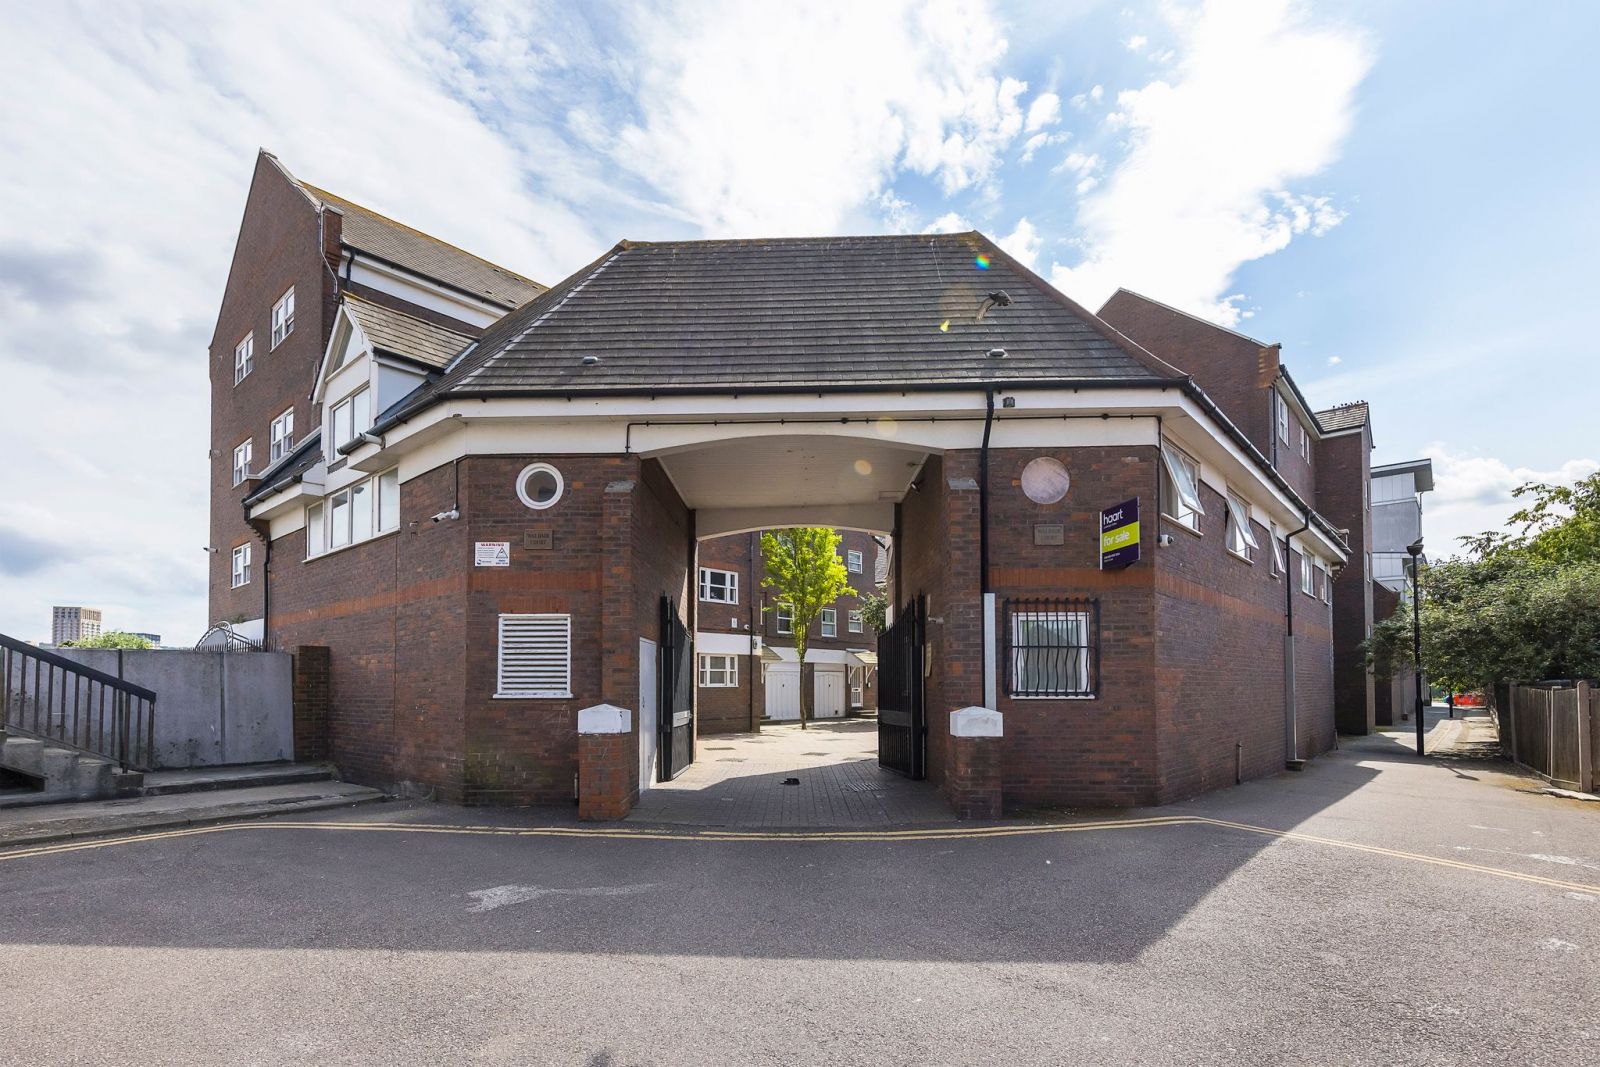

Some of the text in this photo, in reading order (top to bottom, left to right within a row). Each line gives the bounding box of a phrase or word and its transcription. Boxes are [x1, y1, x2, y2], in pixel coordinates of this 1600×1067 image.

[1103, 508, 1124, 525] haart
[1104, 530, 1130, 547] for sale
